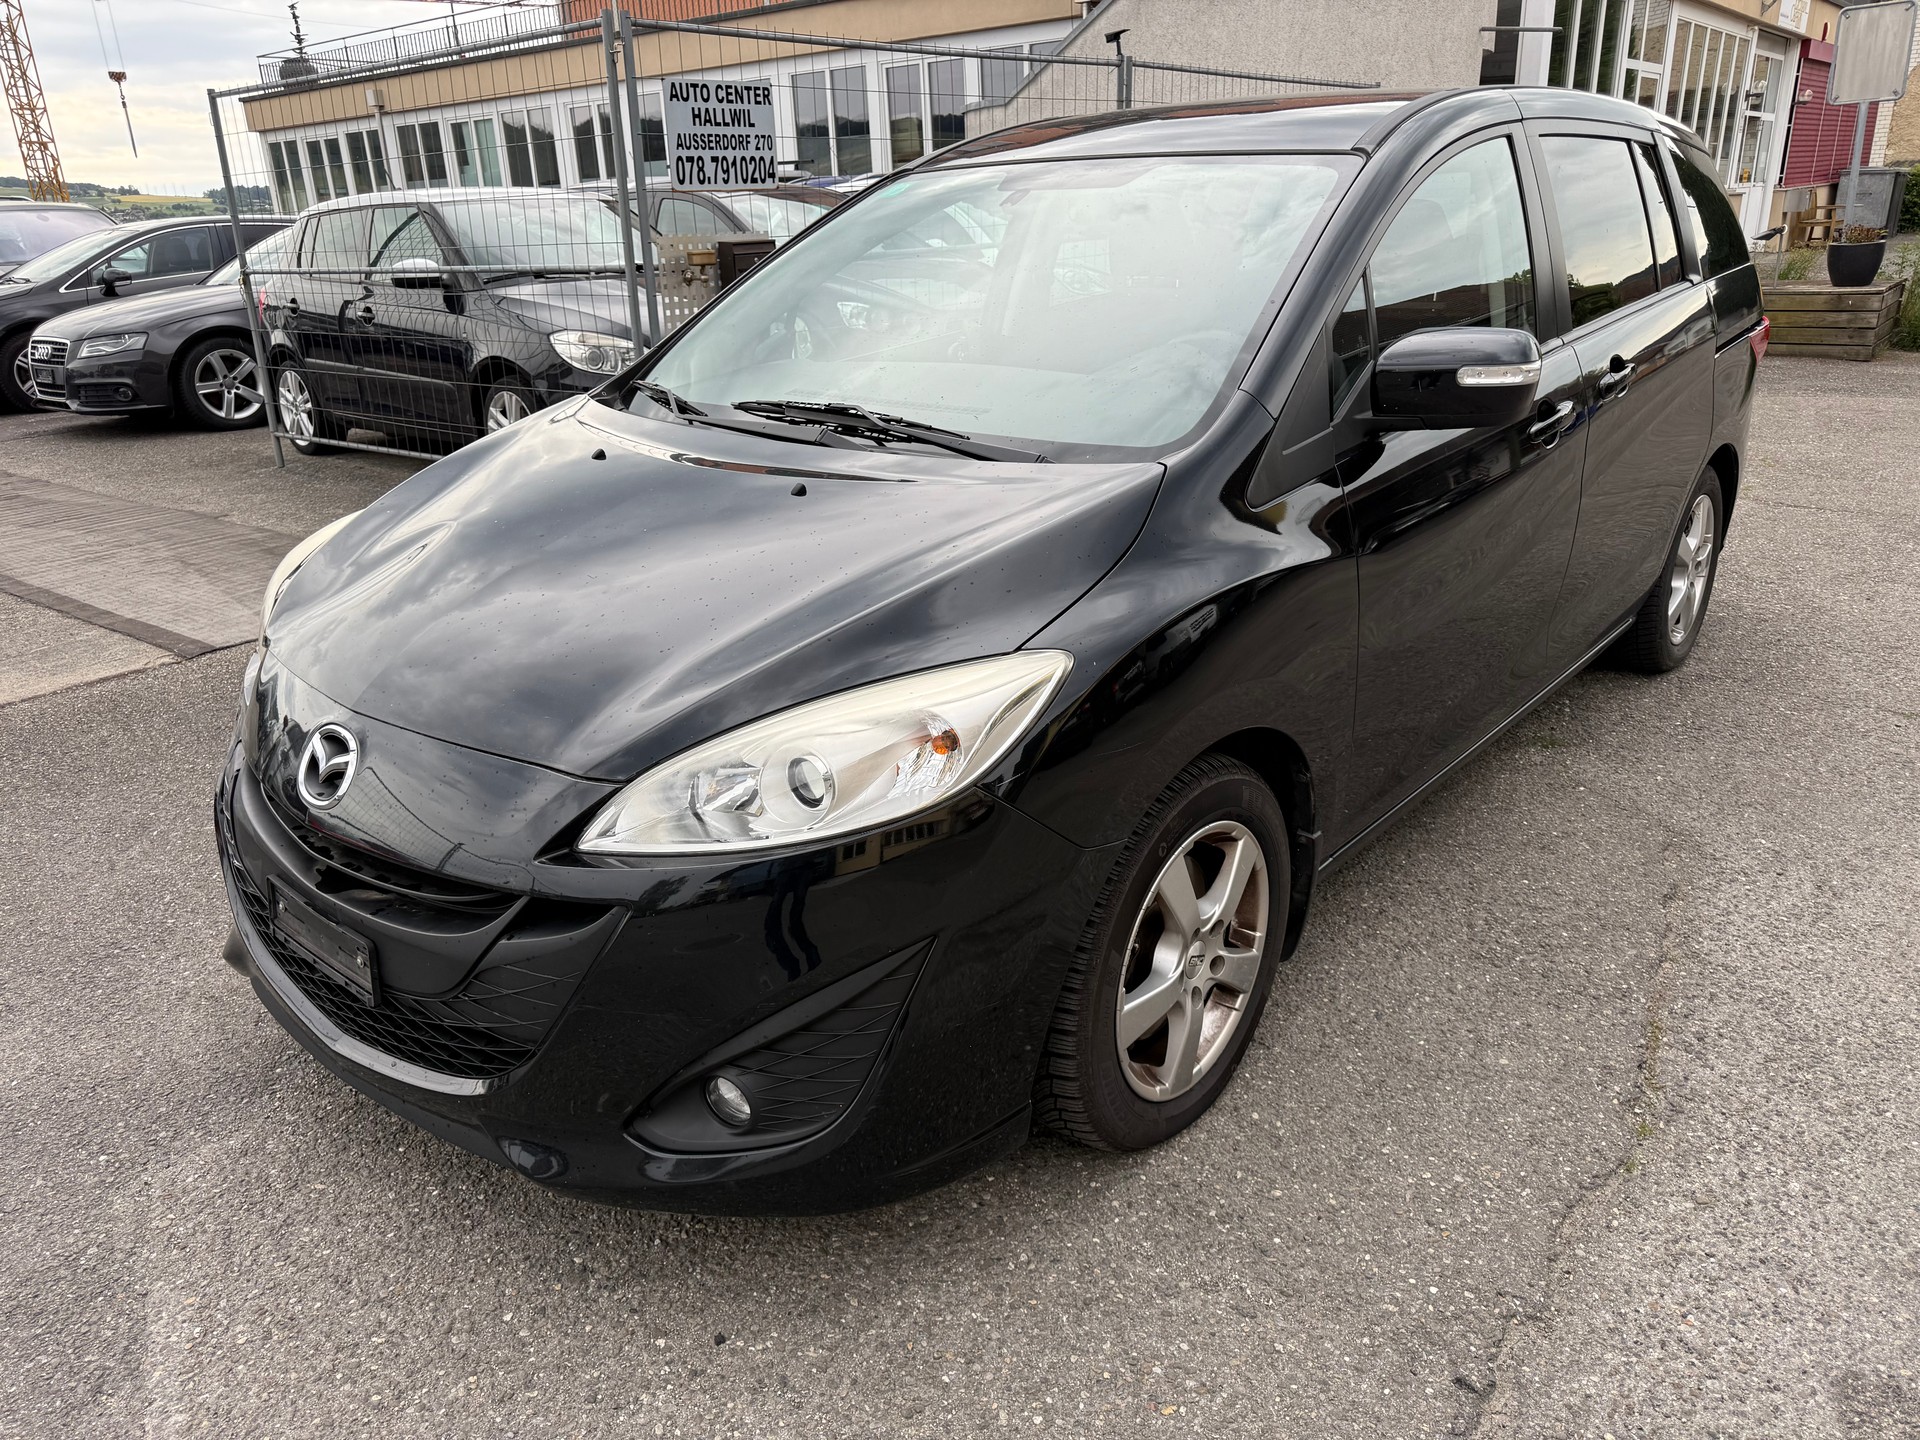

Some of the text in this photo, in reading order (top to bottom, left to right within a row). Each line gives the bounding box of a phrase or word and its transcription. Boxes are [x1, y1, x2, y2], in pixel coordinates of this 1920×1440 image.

[669, 82, 772, 106] AUTO CENTER
[691, 107, 756, 128] HALLWIL
[676, 133, 773, 151] AUSSERDORF 270
[675, 155, 776, 185] 078.7910204
